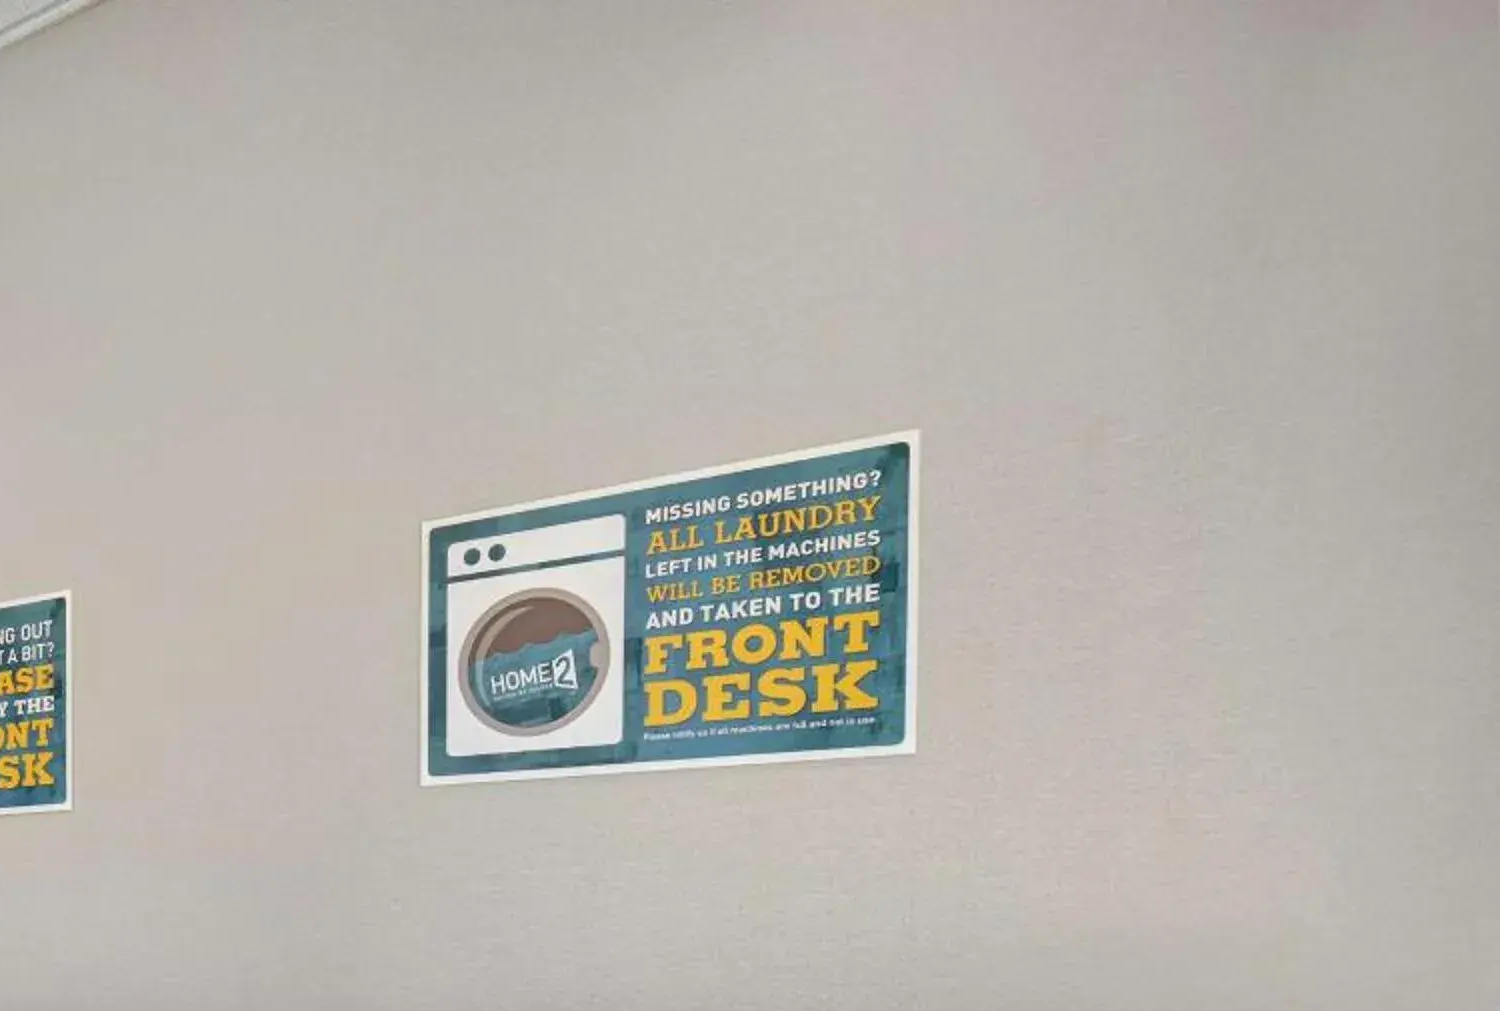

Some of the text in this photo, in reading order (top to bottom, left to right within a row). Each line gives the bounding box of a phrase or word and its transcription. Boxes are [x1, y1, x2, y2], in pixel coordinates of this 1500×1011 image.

[646, 469, 882, 524] MISSING SOMETHING?
[647, 495, 881, 555] ALL LAUNDRY
[645, 530, 881, 579] LEFT IN THE MACHINES
[647, 556, 882, 604] WILL BE REMOVED
[21, 619, 53, 641] OUT
[646, 583, 881, 630] AND TAKEN TO THE
[7, 648, 18, 664] A
[21, 641, 55, 661] BIT?
[644, 610, 880, 675] FRONT
[14, 695, 55, 715] THE
[644, 660, 879, 727] DESK
